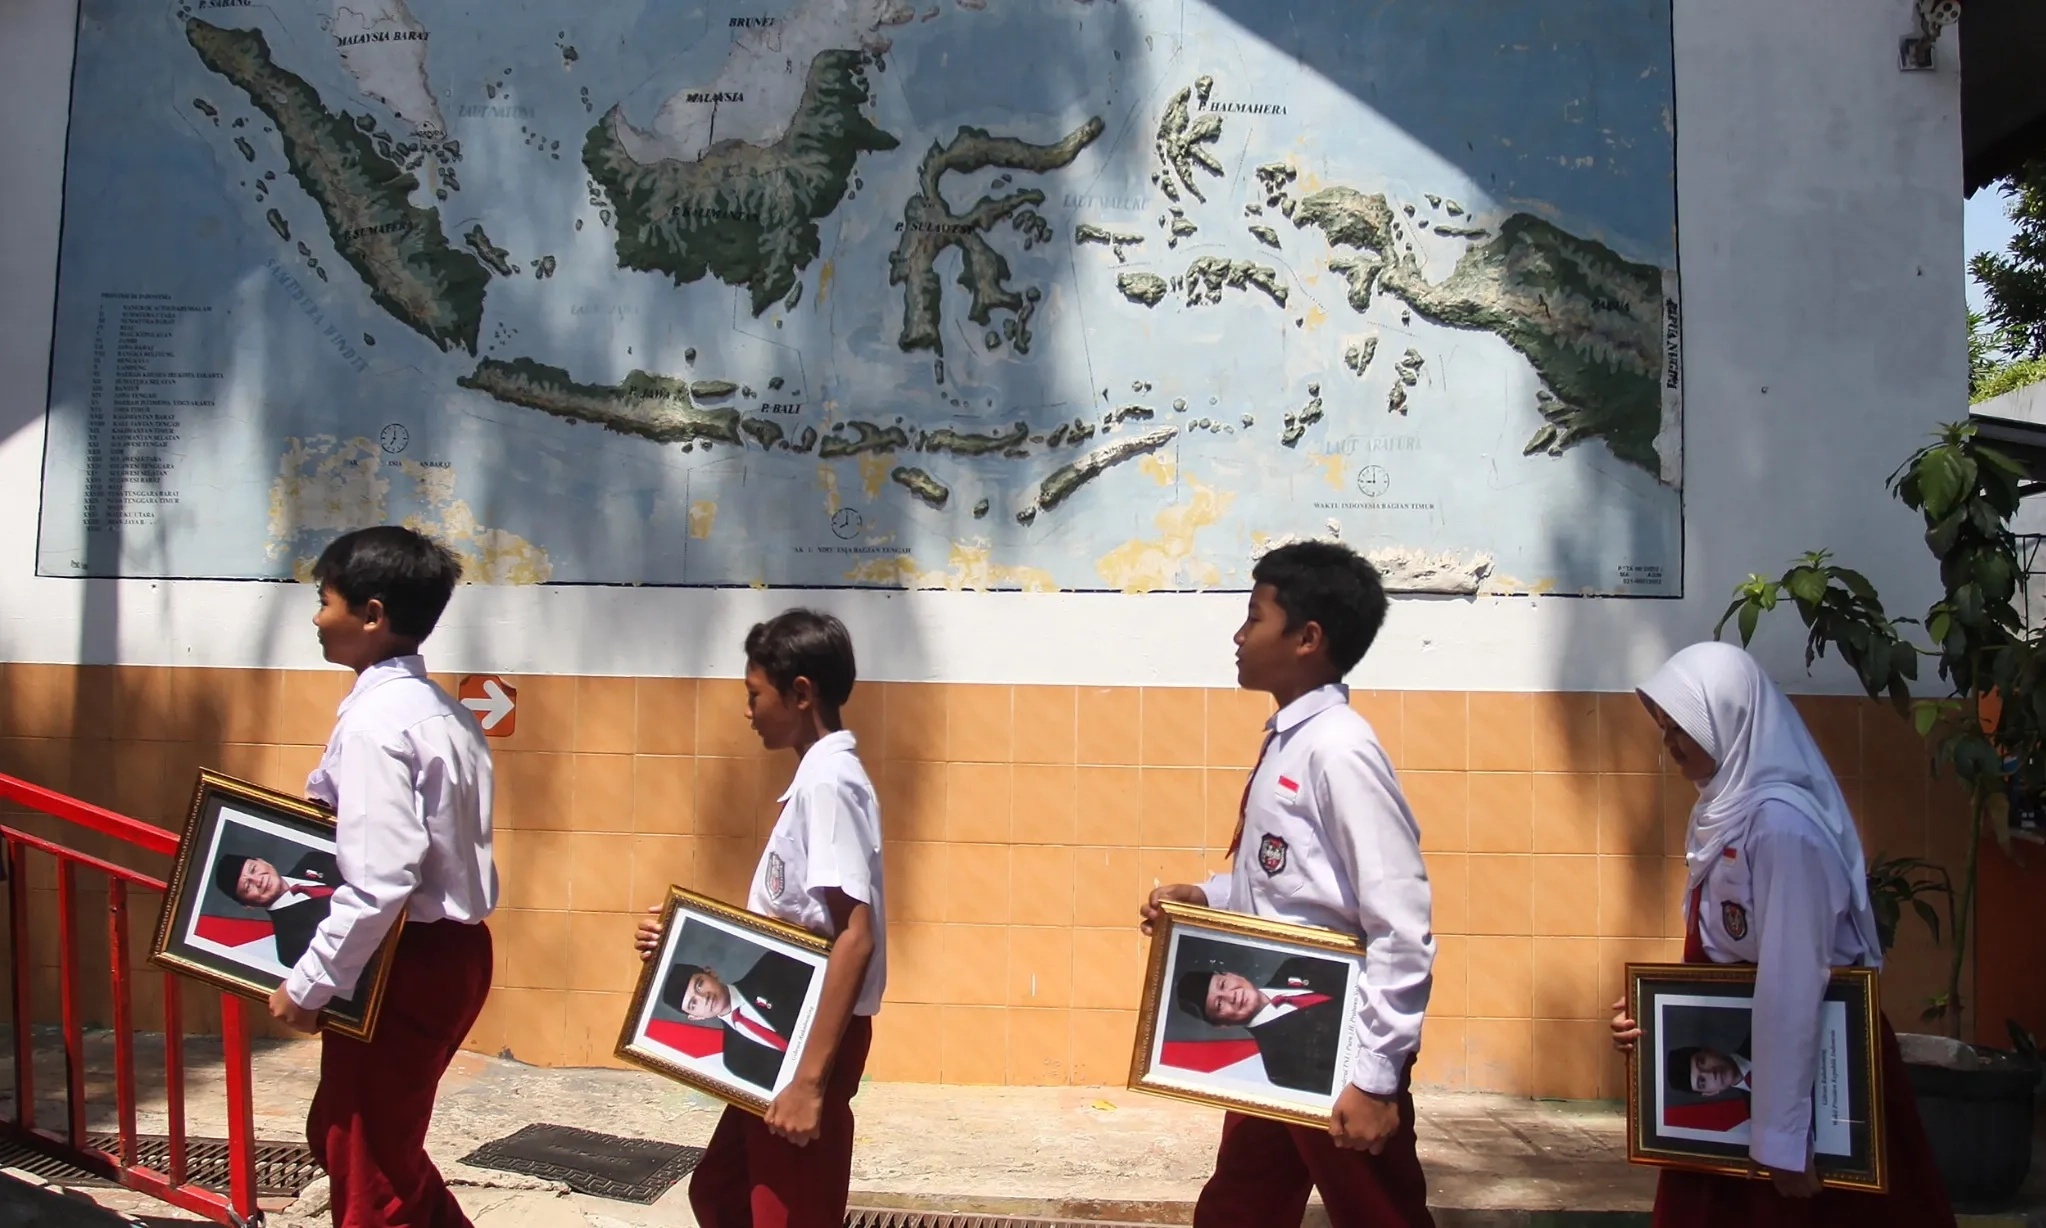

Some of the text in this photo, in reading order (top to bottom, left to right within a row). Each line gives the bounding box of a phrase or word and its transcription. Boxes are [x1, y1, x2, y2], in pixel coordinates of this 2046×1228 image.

[338, 30, 430, 46] MALAYSIA BARAT
[1210, 101, 1287, 115] HALMAHERA
[772, 403, 801, 415] BALI
[1313, 501, 1435, 510] WAKTU INDONESIA BAGIAN TIMUR
[881, 546, 911, 554] TENGAH
